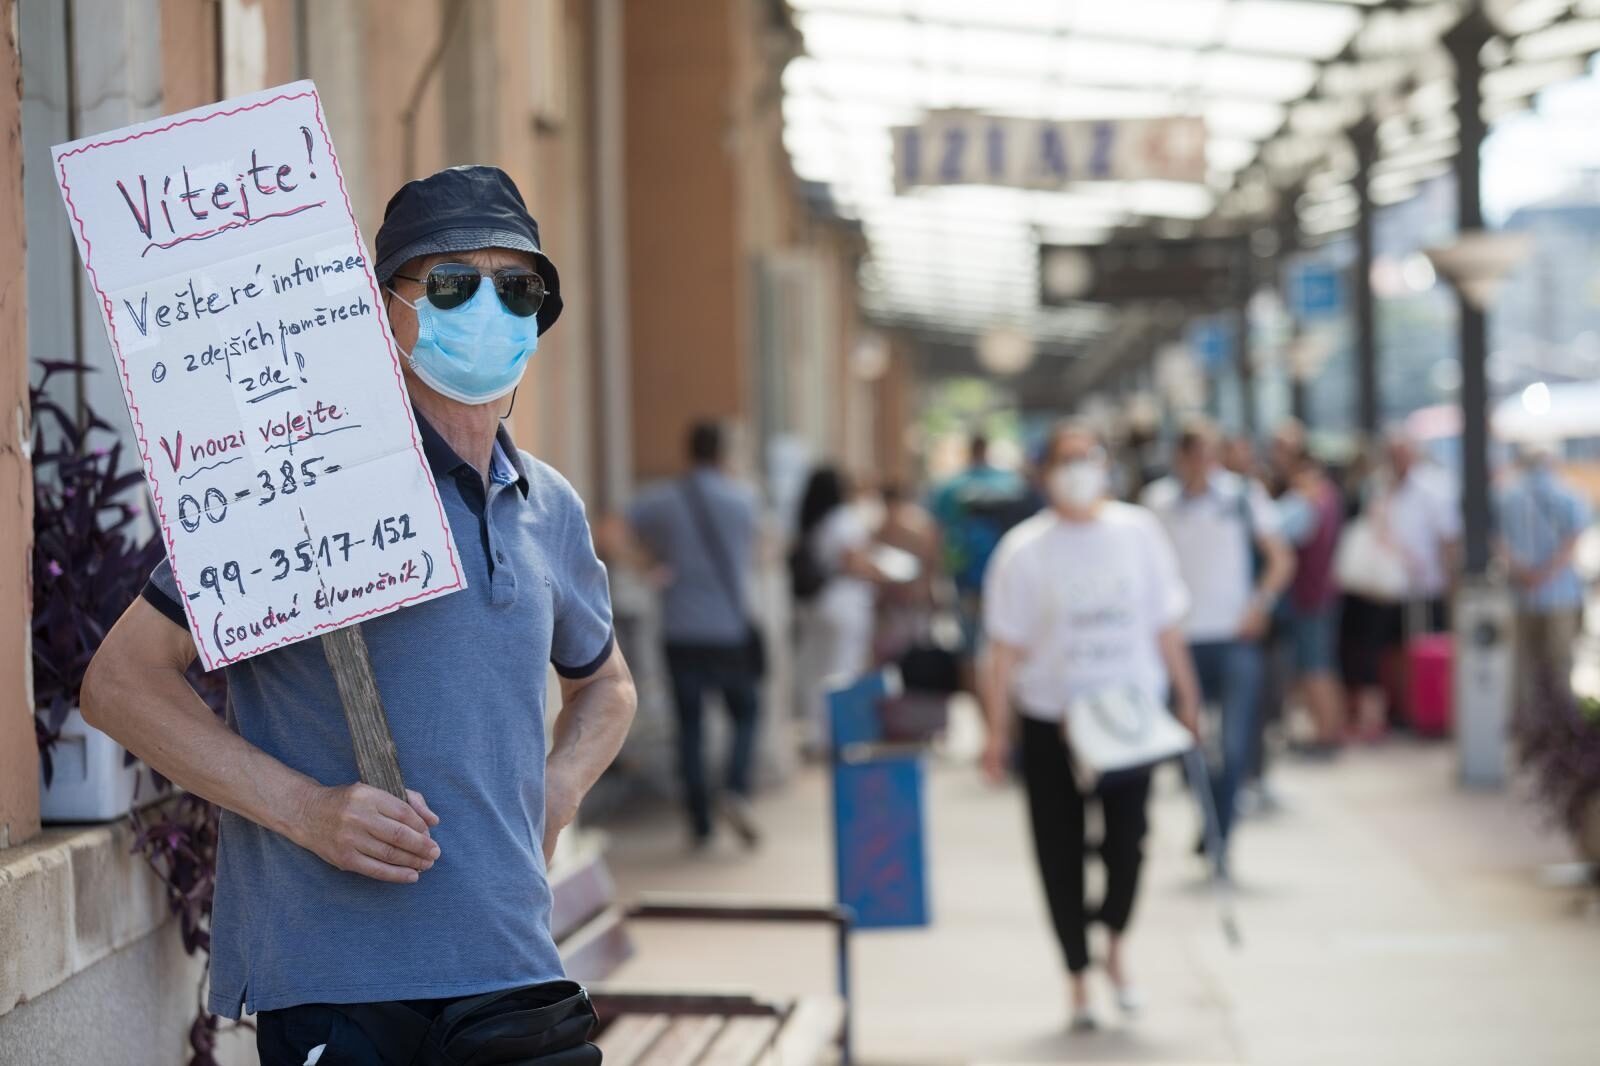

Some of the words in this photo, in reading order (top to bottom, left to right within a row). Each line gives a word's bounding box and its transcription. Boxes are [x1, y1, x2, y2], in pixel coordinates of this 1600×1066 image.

[117, 126, 317, 239] Vítejte!
[124, 265, 264, 337] Veškeré
[184, 321, 274, 384] zdejších
[278, 296, 371, 366] poměrech
[239, 351, 308, 392] zde!
[160, 431, 182, 473] V
[190, 430, 246, 462] nouzi
